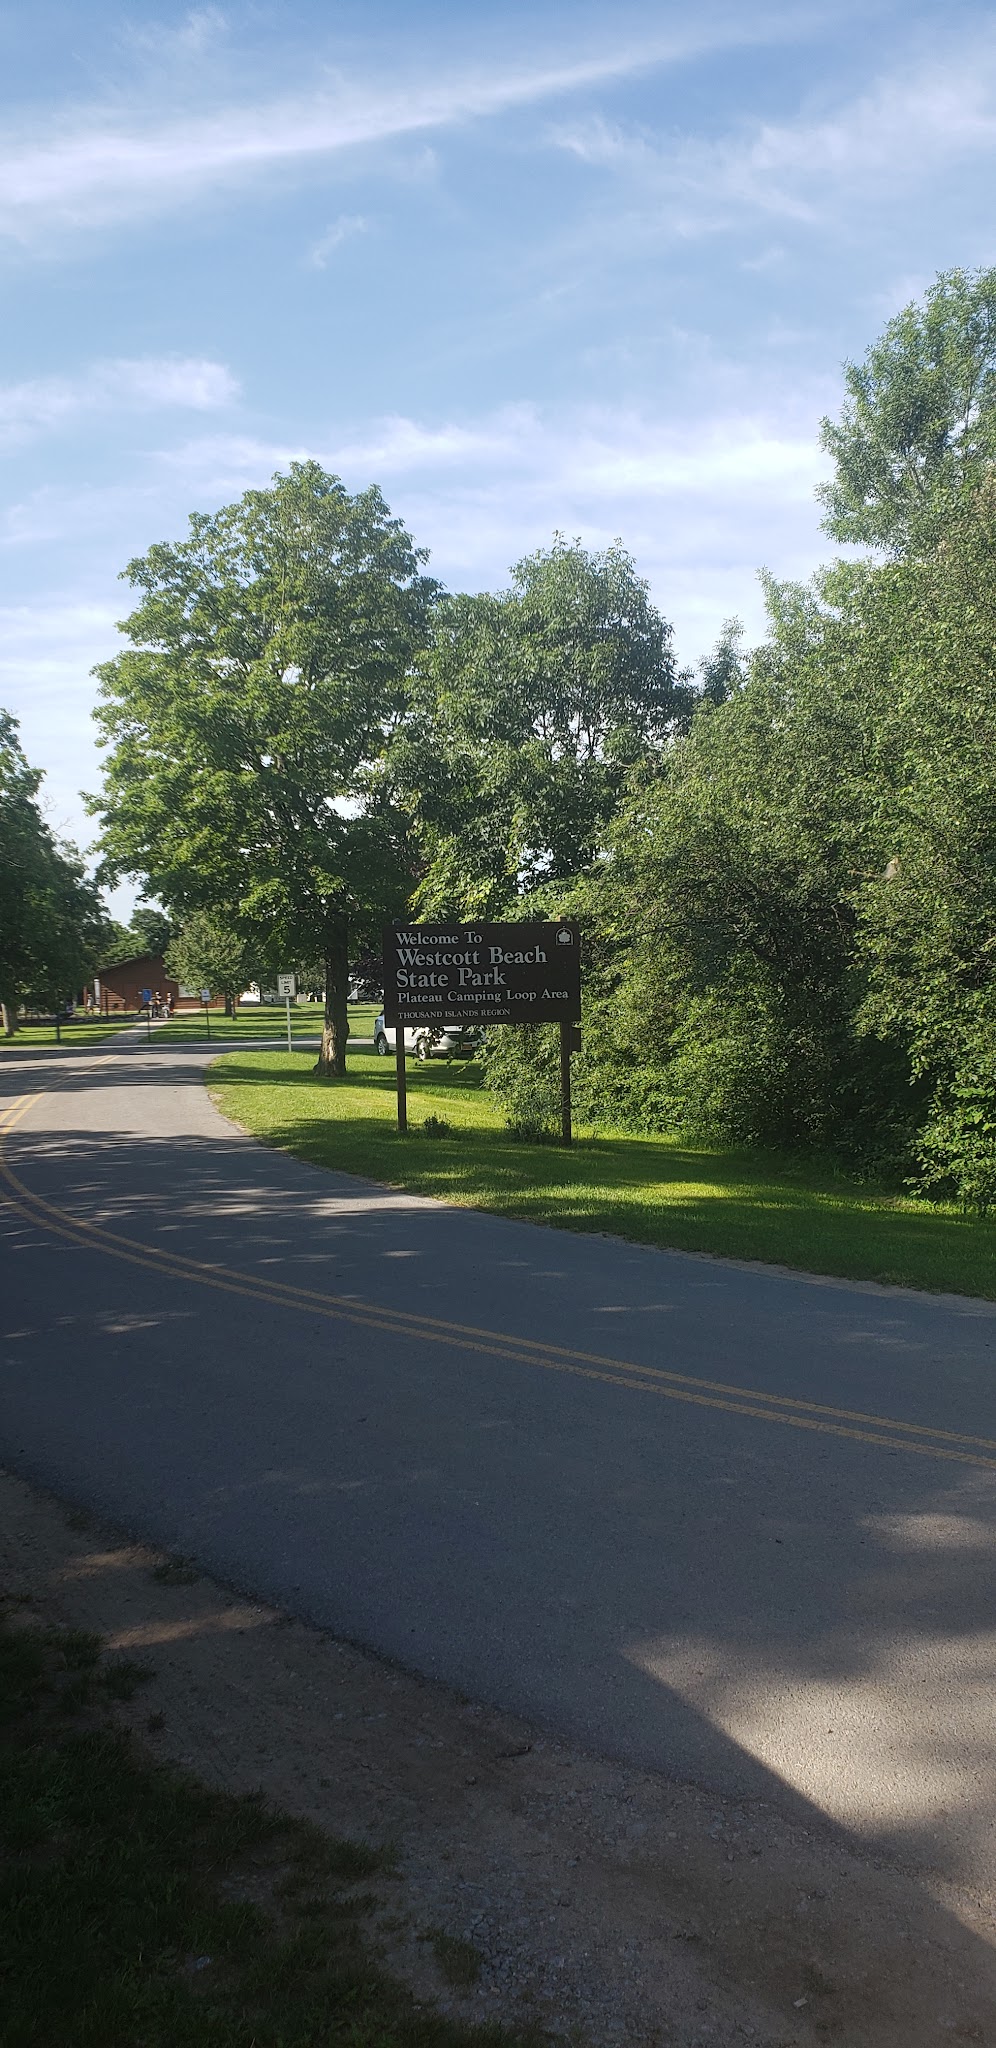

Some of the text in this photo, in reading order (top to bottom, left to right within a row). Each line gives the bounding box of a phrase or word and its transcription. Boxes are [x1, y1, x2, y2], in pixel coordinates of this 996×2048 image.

[396, 931, 483, 945] Welcome To
[396, 945, 548, 966] Westcott Beach
[396, 966, 507, 988] State Park
[397, 988, 569, 1003] Plateau Camping Loop Area
[397, 1008, 511, 1019] THOUSAND ISLANDS REGION
